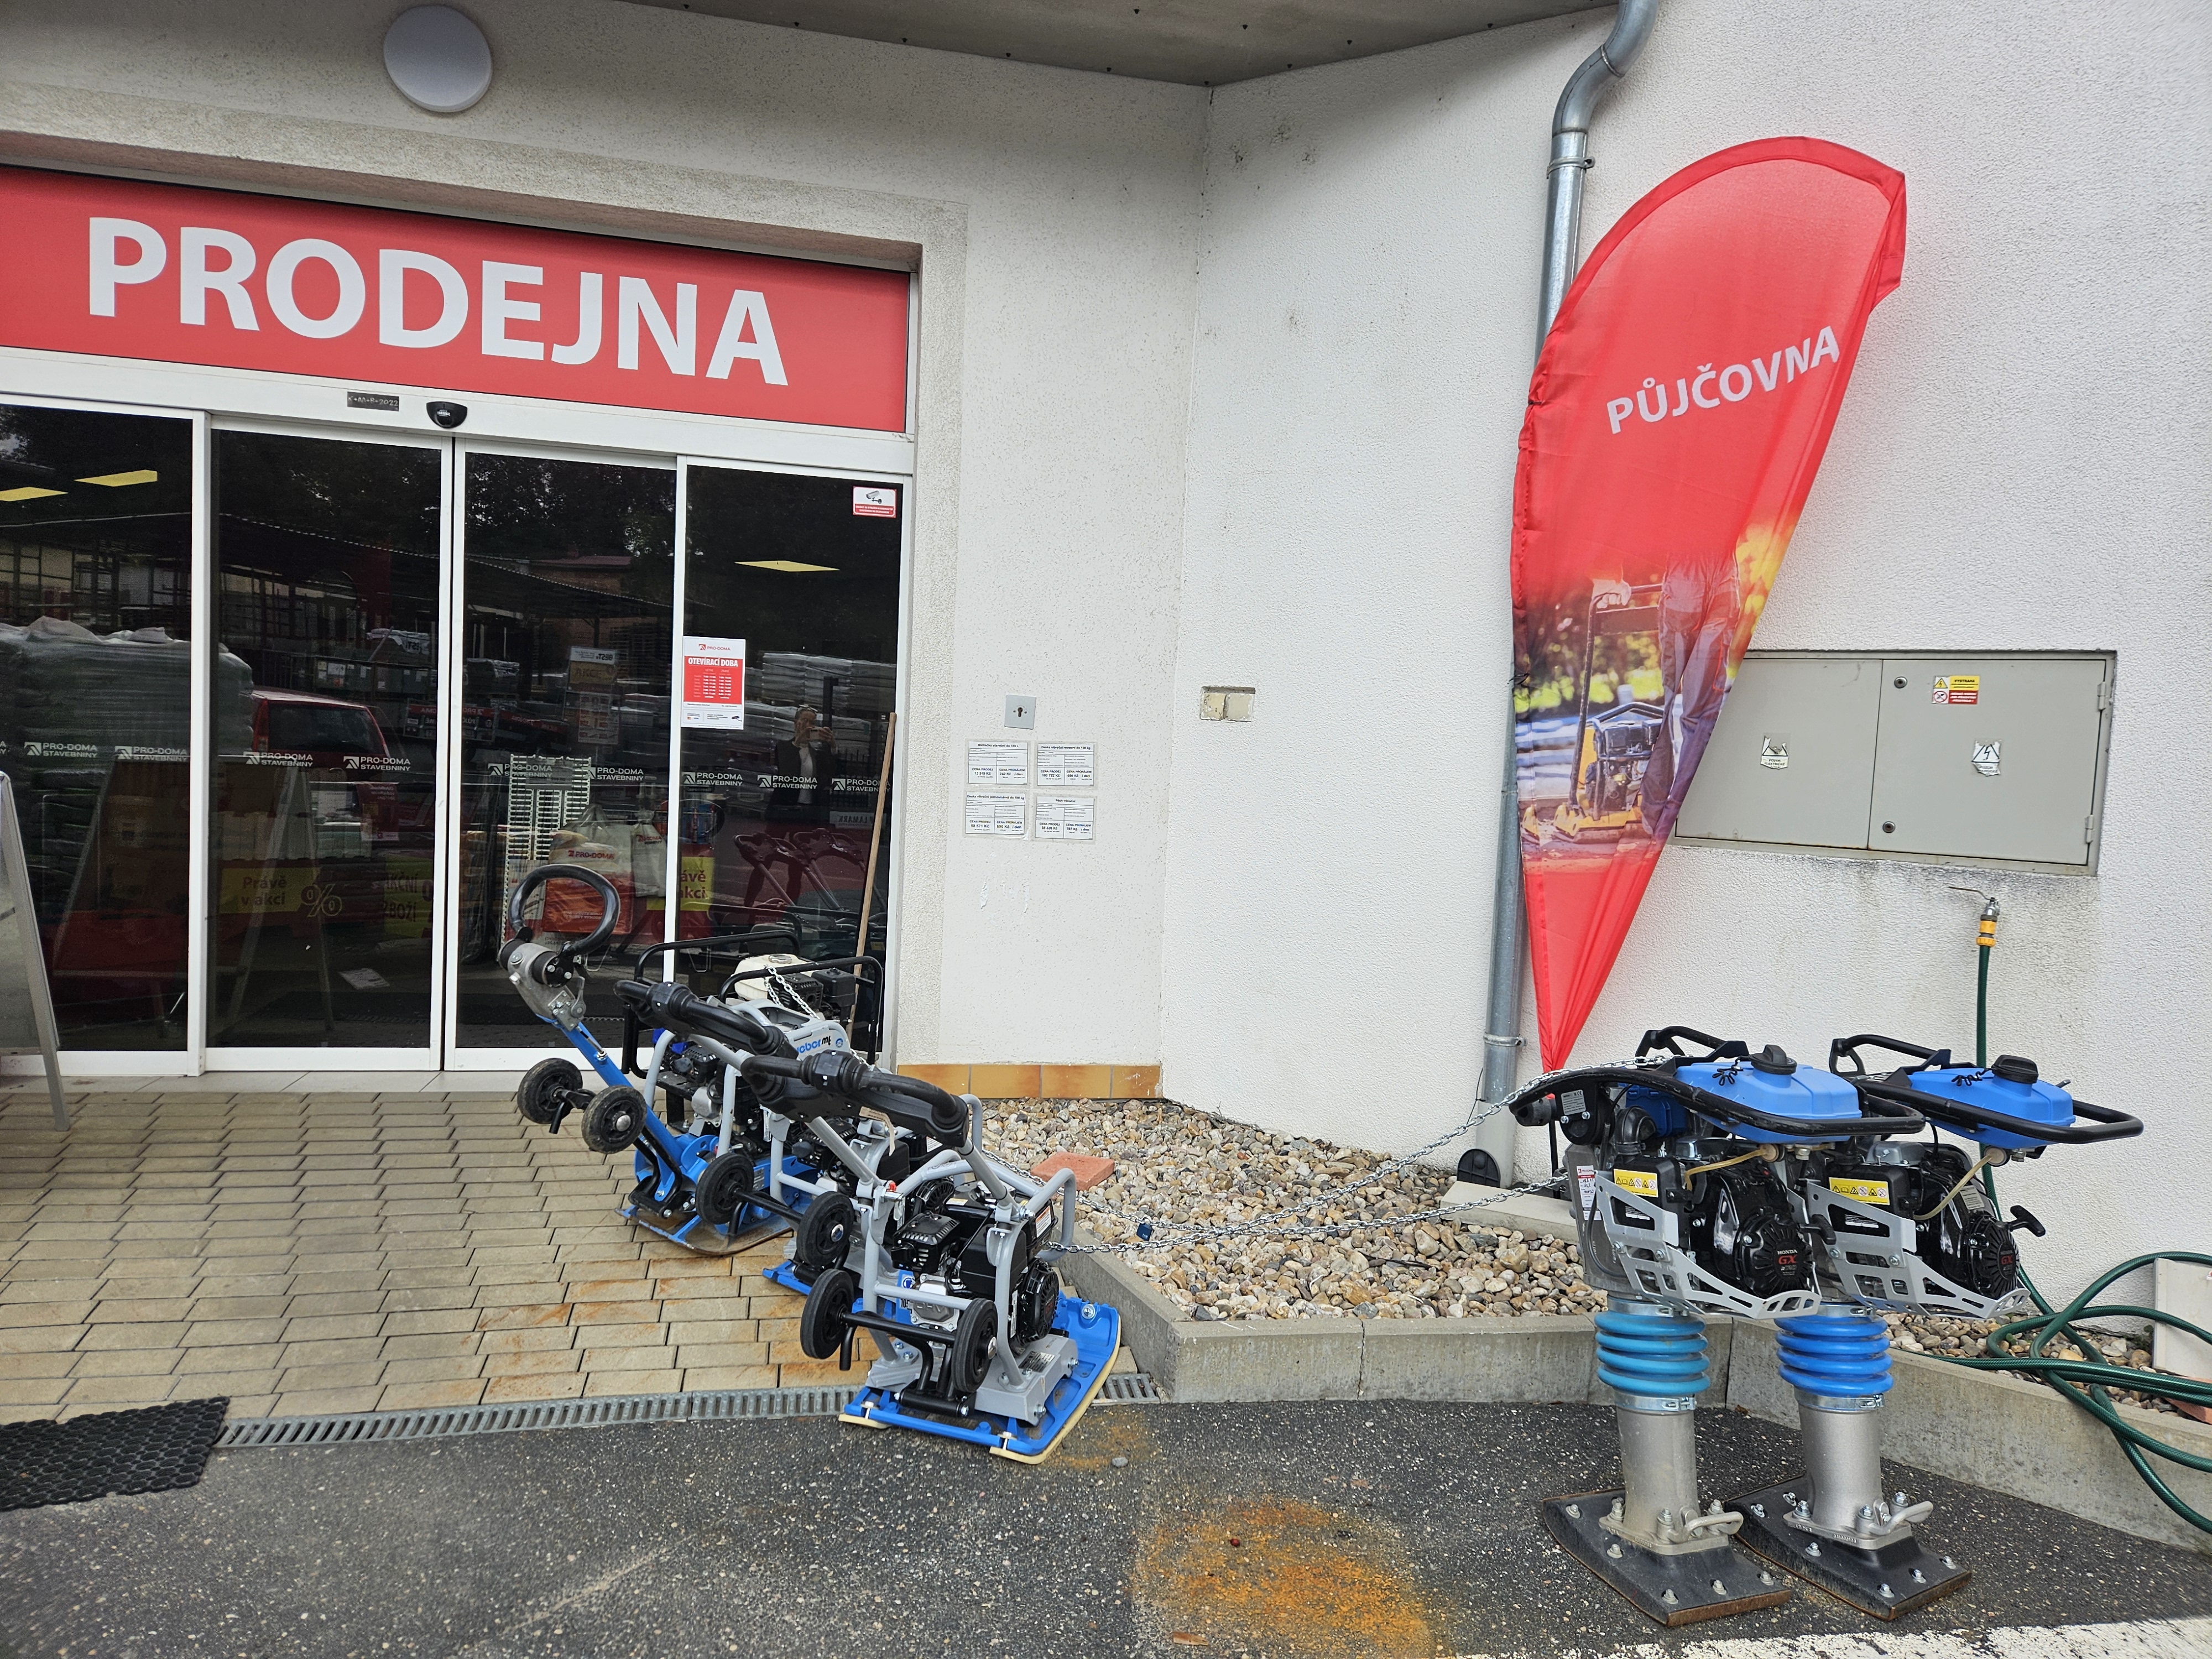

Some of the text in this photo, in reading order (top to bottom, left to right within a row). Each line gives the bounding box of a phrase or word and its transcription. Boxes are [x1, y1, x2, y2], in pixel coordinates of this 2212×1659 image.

[89, 216, 788, 386] PRODEJNA
[1606, 326, 1839, 434] PŮJČOVNA
[688, 657, 720, 666] OTEVÍRACÍ
[43, 742, 97, 752] PRO-DOMA
[133, 746, 187, 755] PRO-DOMA
[43, 750, 97, 758] STAVEBNINY
[261, 752, 313, 761] PRO-DOMA
[361, 757, 410, 765] PRO-DOMA
[504, 764, 552, 772] PRO-DOMA
[597, 767, 644, 775] PRO-DOMA
[697, 772, 743, 780] PRO-DOMA
[773, 775, 817, 784] PRO-DOMA
[847, 779, 891, 787] PRO-DOA
[575, 851, 614, 859] PRO-DOMA
[680, 870, 706, 883] ávě
[243, 875, 288, 889] Právě
[241, 895, 249, 905] v
[253, 893, 286, 906] akci
[1778, 1255, 1797, 1265] GX
